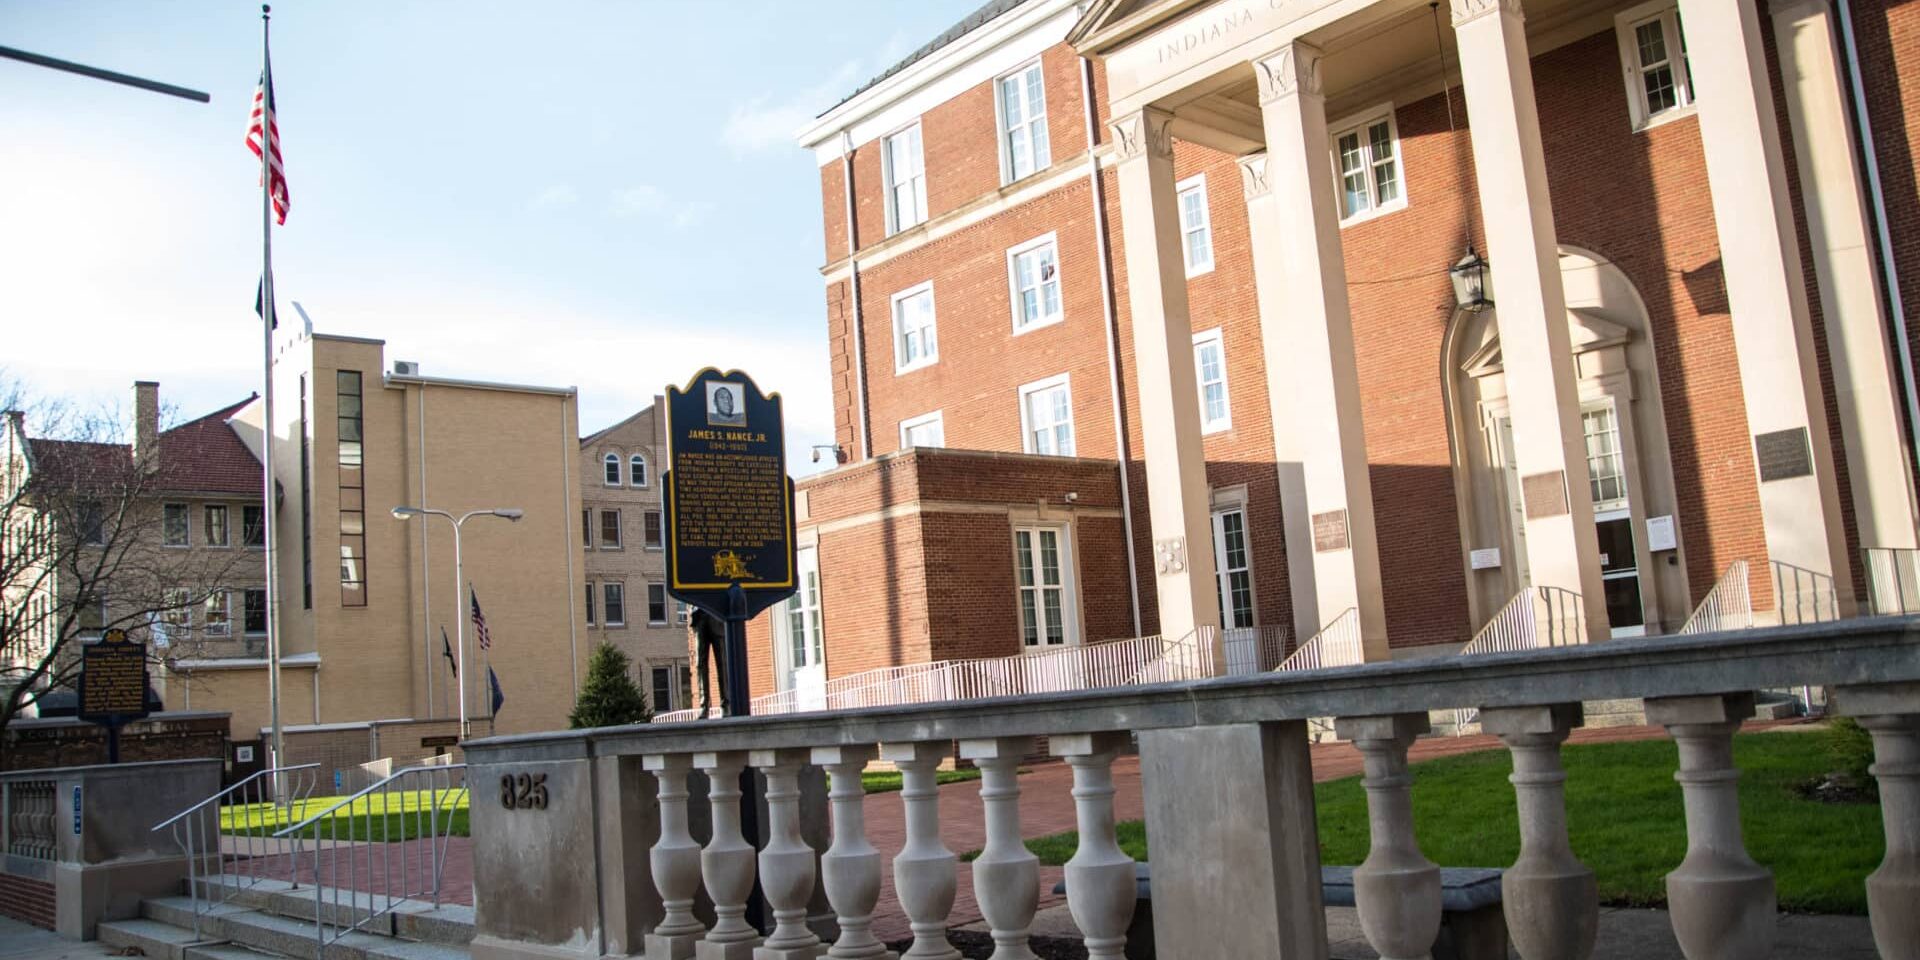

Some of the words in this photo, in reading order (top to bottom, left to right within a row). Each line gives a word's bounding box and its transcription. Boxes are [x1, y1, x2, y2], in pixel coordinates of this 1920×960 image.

[1157, 8, 1254, 63] INDIANA
[688, 431, 716, 440] JAMES
[500, 773, 548, 810] 825
